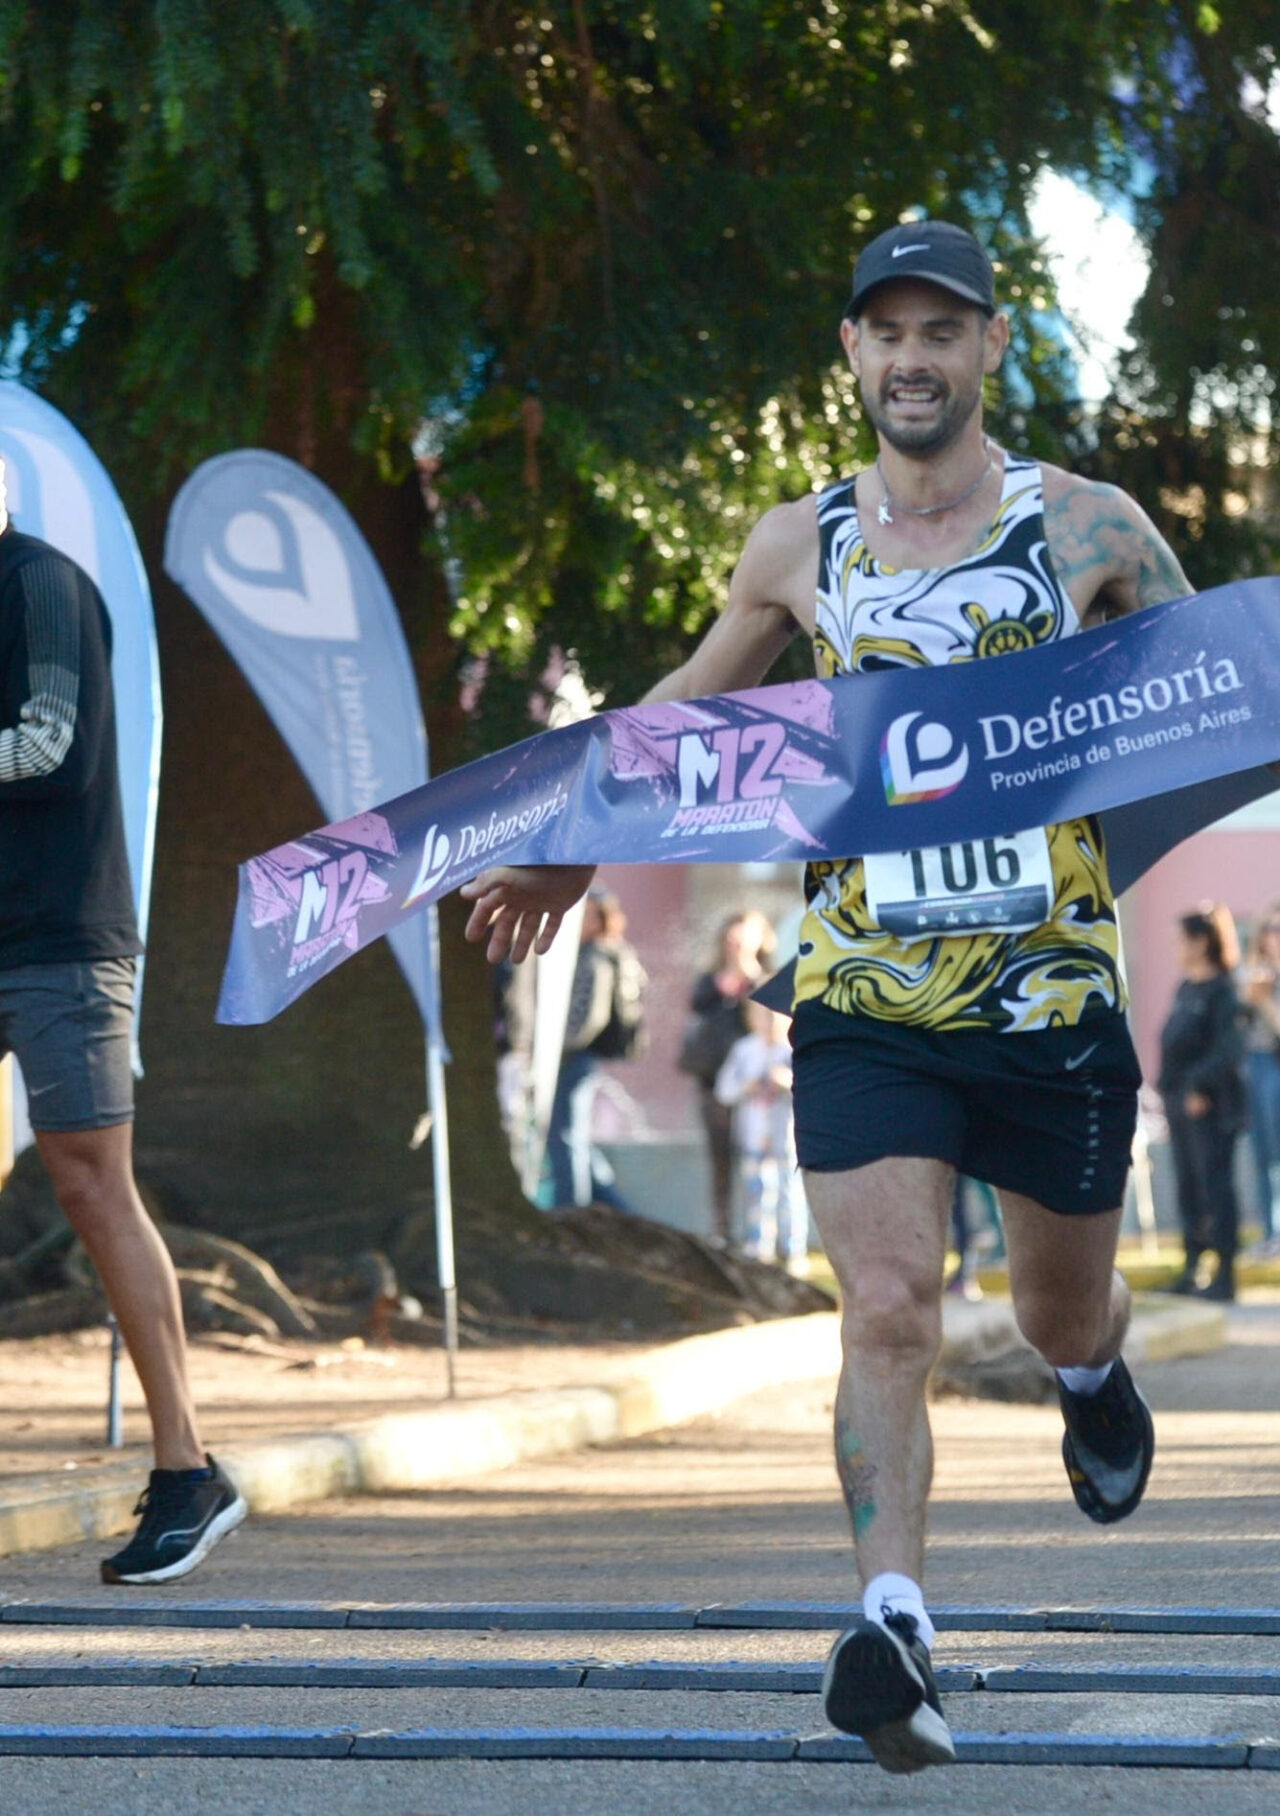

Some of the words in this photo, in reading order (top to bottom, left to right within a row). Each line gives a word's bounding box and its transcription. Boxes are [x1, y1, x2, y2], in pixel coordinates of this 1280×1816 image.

[978, 650, 1245, 761] Defensoría
[990, 754, 1081, 791] Provincia
[1086, 745, 1111, 766] de
[1115, 721, 1194, 757] Buenos
[1199, 704, 1252, 733] Aires
[677, 722, 787, 808] M12
[668, 797, 779, 830] MARATON
[901, 833, 1021, 898] 106
